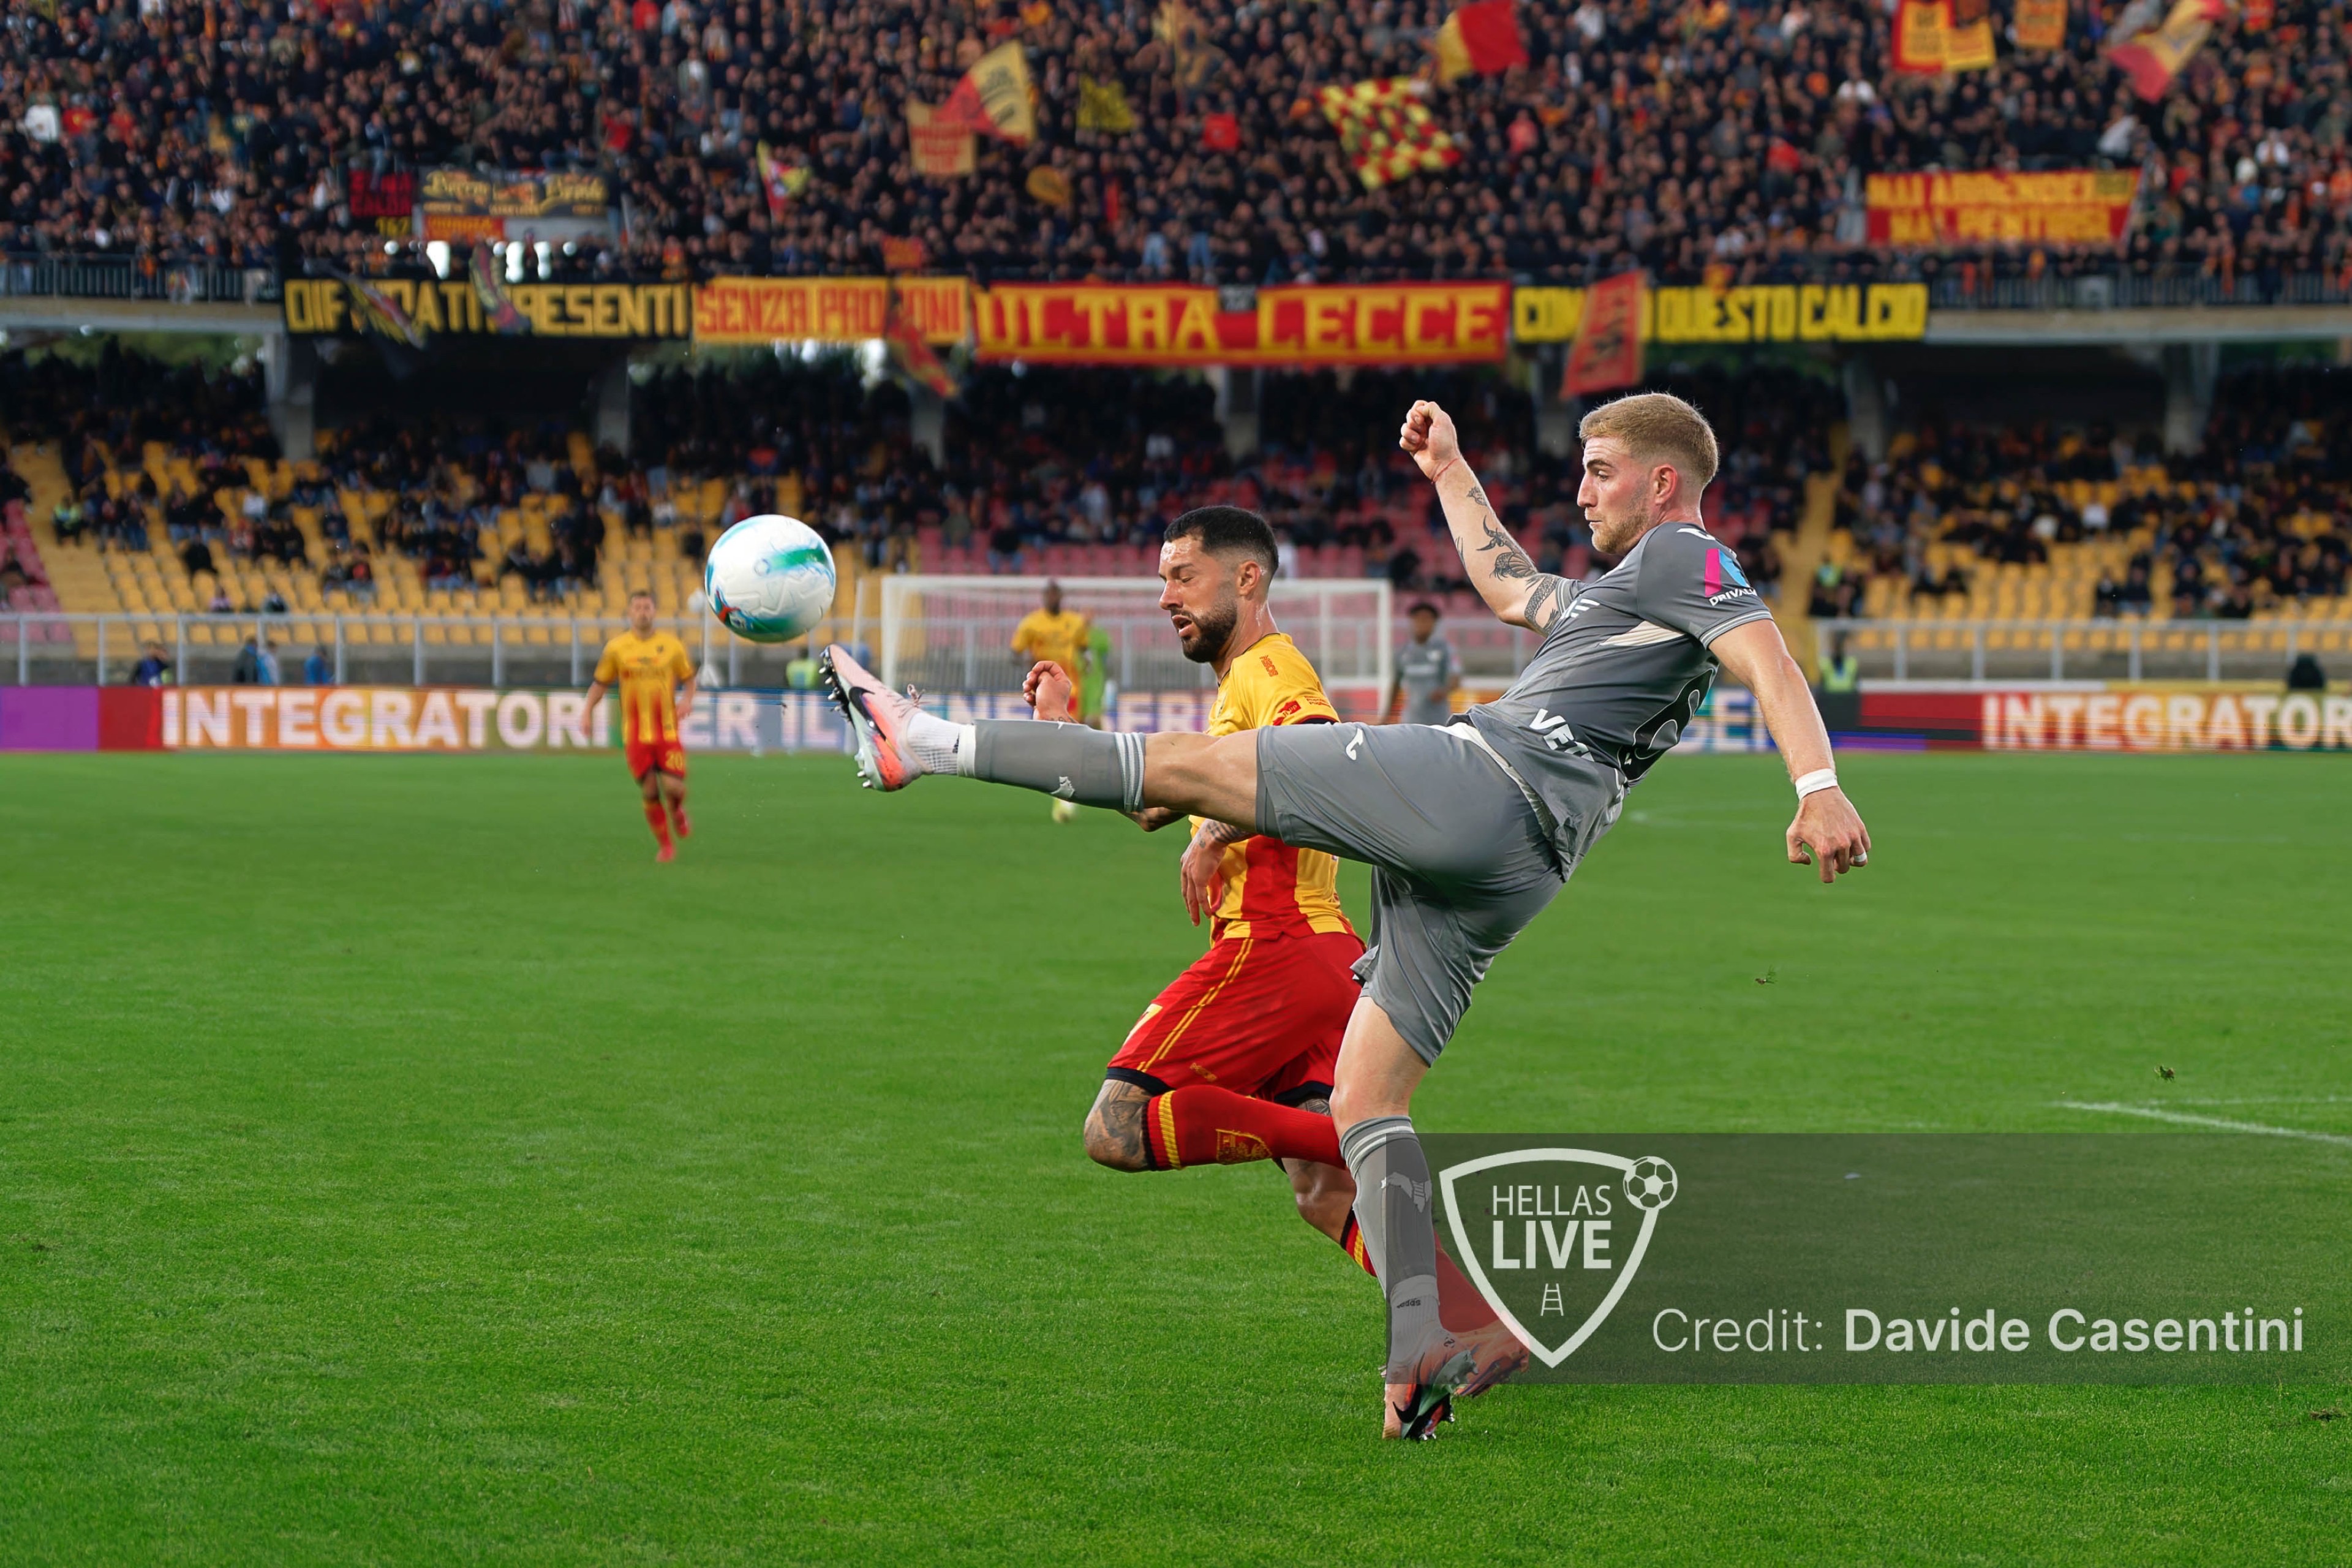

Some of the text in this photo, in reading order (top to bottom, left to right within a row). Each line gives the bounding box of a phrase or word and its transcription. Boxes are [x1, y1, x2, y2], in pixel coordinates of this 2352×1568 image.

[284, 279, 687, 336] DIFDATI RESENTI
[697, 285, 960, 335] SENZA PADONI
[973, 290, 1221, 350] ULTRA
[1257, 284, 1502, 355] LECCE
[1657, 284, 1797, 343] QUESTO
[162, 691, 611, 748] INTEGRATORI
